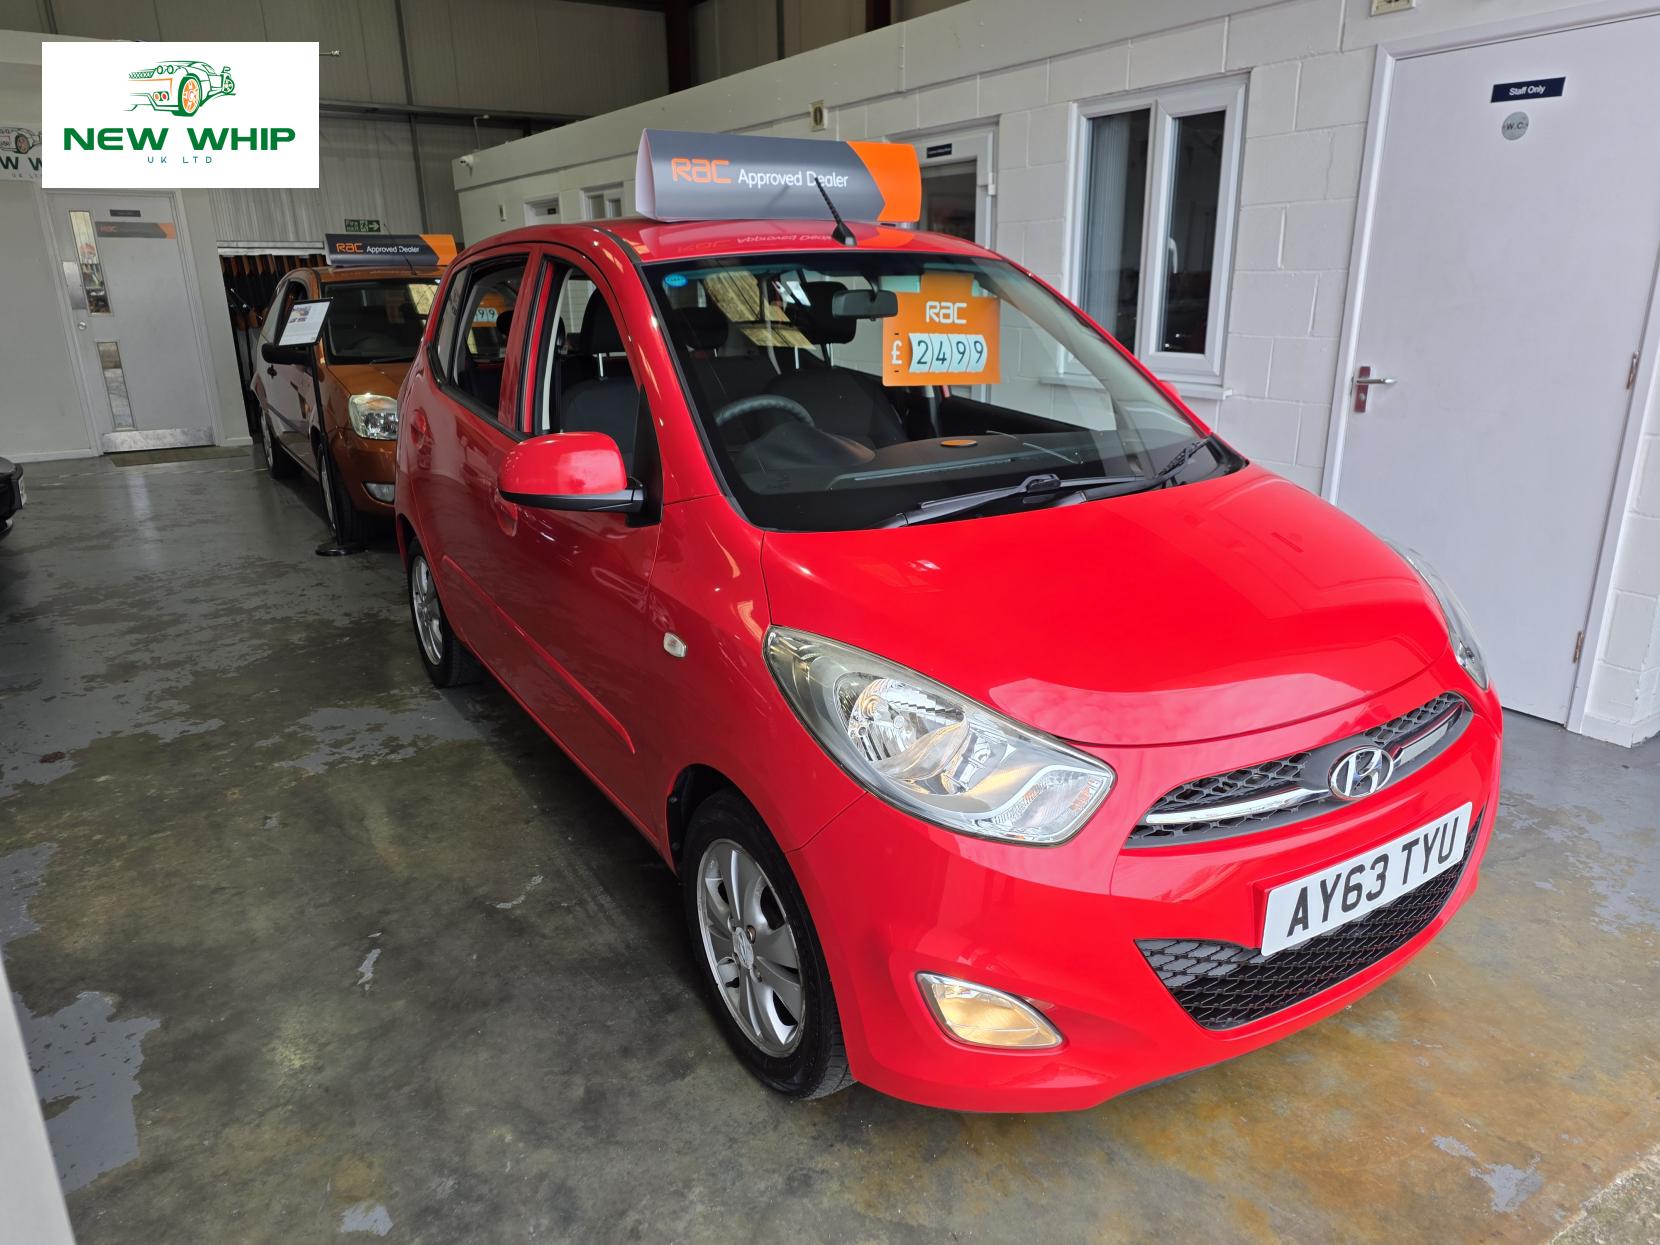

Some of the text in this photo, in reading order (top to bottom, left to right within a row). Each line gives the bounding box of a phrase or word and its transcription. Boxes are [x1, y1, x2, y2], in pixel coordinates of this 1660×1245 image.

[1509, 85, 1546, 96] Staff Only
[737, 168, 803, 189] Approved
[806, 170, 849, 188] Dealer
[366, 245, 398, 255] Approved
[398, 245, 420, 253] Dealer
[891, 340, 984, 366] £ 2499
[1286, 815, 1460, 938] AY63 TYU
